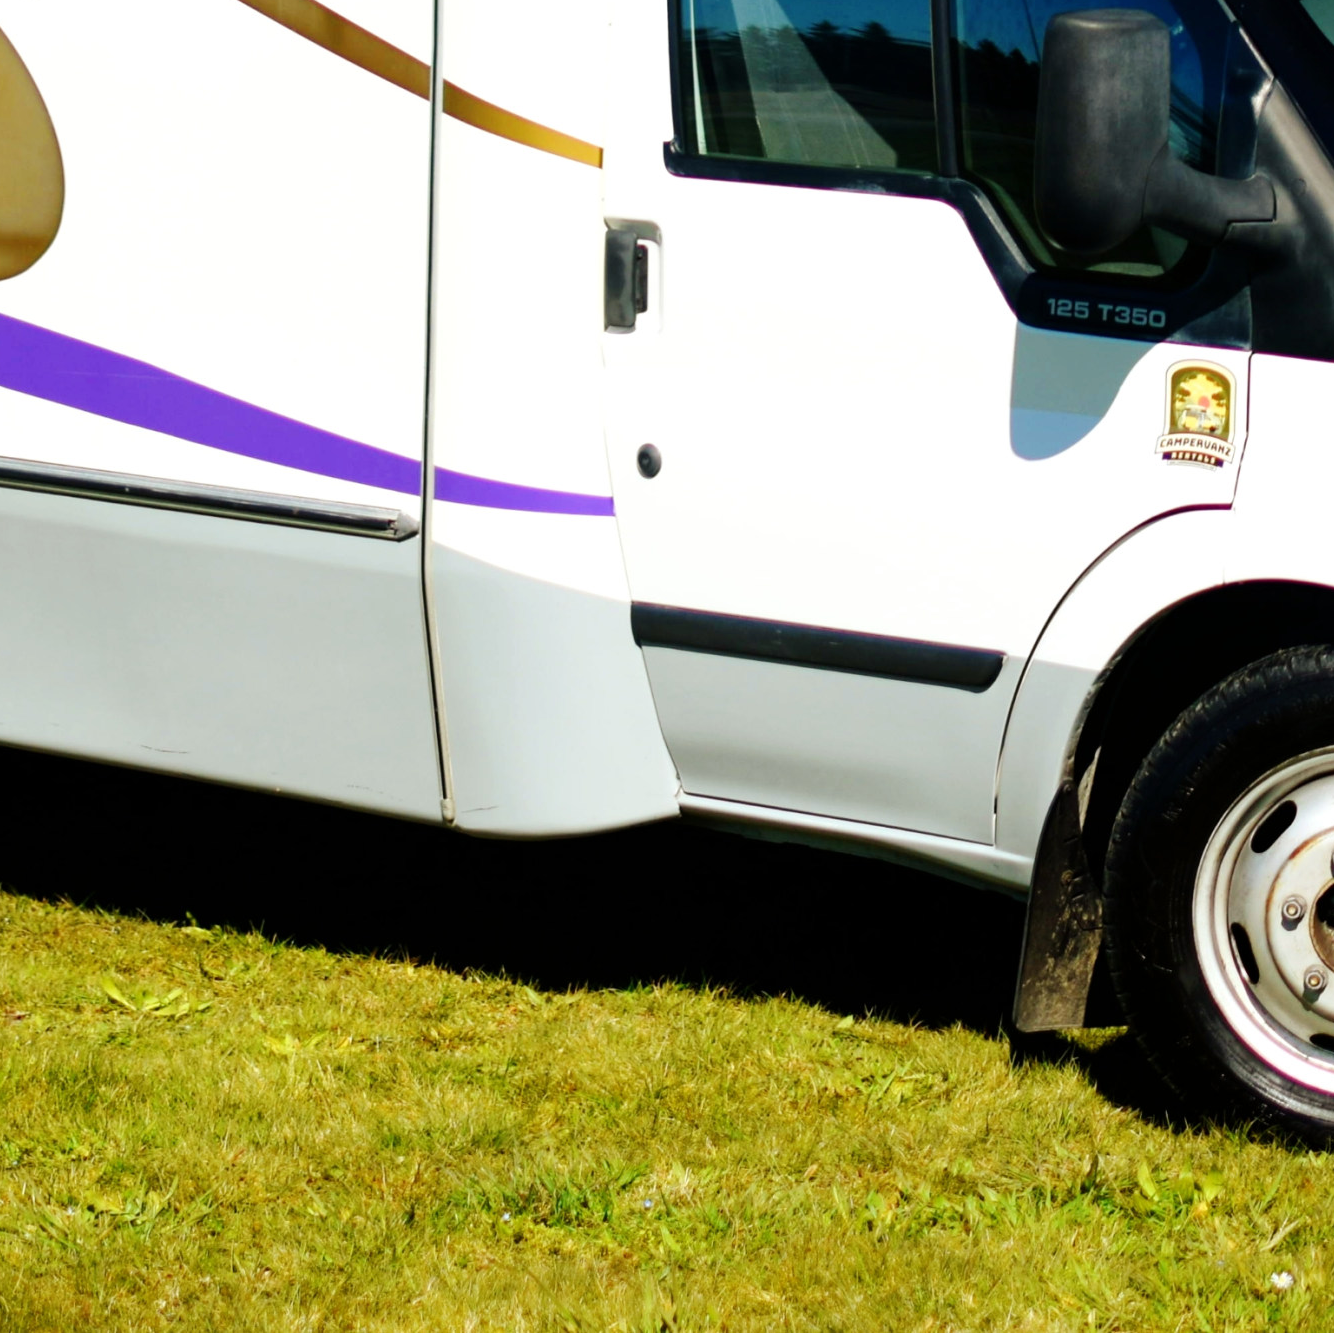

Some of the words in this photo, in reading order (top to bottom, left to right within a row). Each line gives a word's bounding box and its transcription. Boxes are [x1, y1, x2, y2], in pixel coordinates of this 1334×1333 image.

[1047, 298, 1089, 319] 125
[1098, 303, 1166, 327] T350
[1160, 437, 1232, 457] CAMPERVANZ
